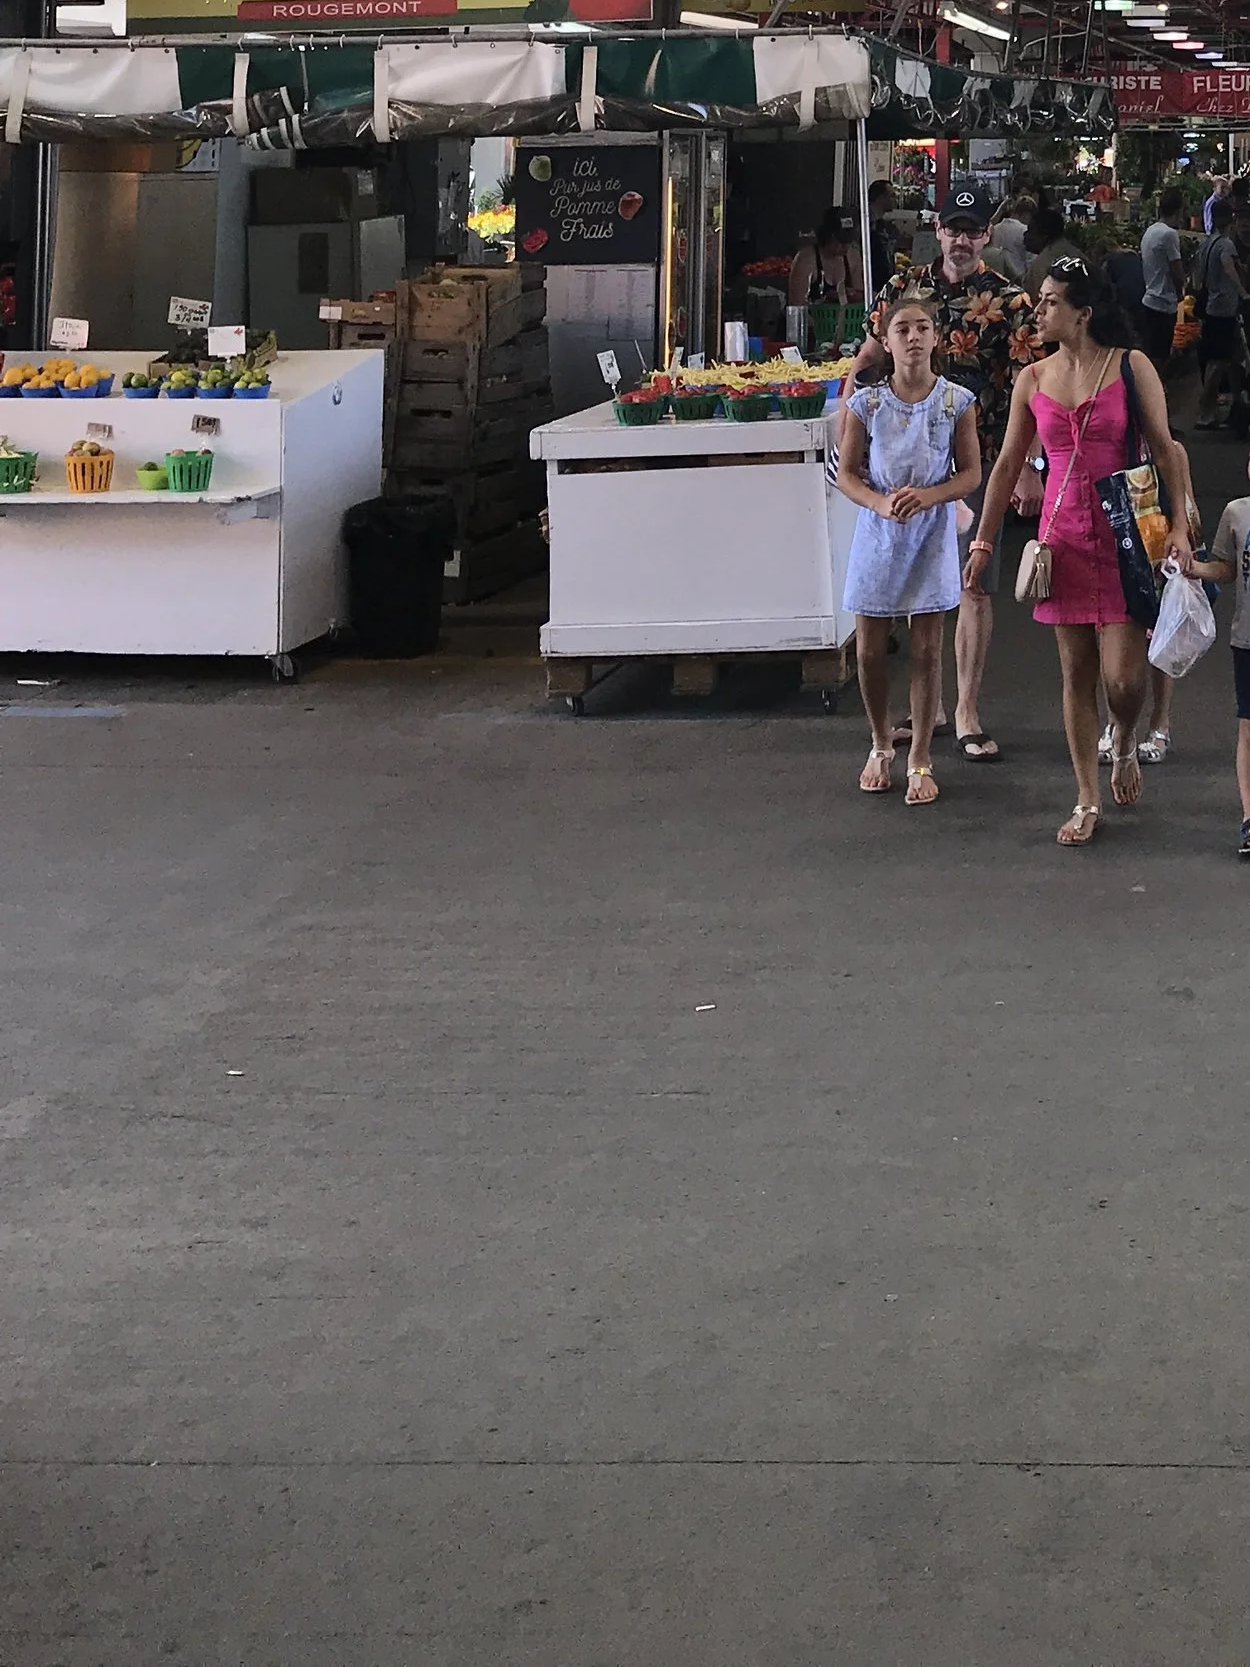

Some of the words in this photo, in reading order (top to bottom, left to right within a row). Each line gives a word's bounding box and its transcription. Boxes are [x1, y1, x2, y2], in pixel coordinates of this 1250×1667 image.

[272, 0, 422, 18] ROUGEMONT
[1117, 94, 1165, 114] aniel
[605, 178, 621, 191] de
[549, 195, 616, 218] Pomme
[560, 218, 614, 242] Frais
